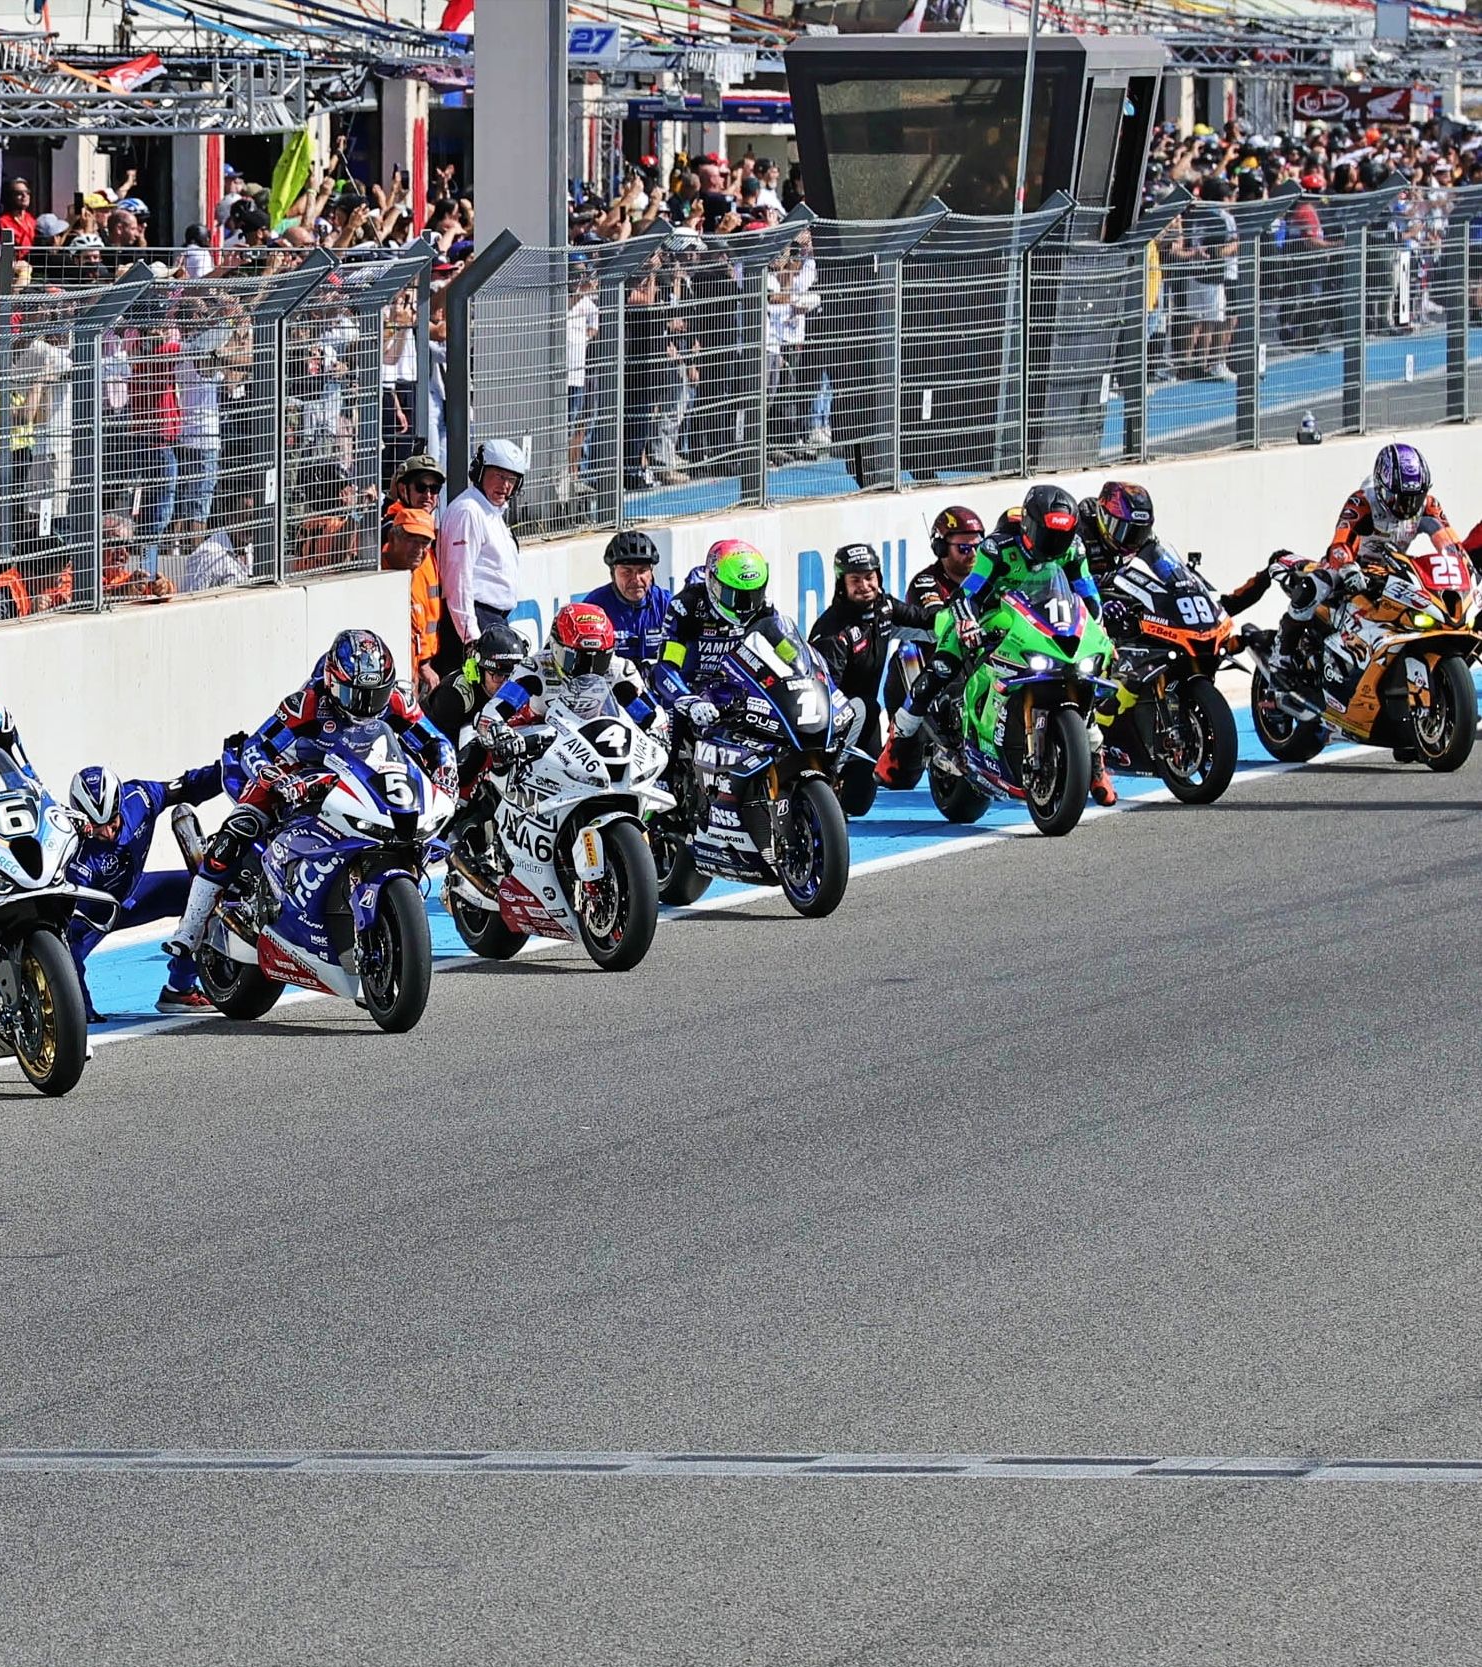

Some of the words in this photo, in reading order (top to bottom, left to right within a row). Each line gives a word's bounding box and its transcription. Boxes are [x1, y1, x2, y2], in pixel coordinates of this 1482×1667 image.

[568, 28, 616, 54] 27
[1429, 556, 1463, 585] 25
[1143, 614, 1169, 626] YAMAHA
[1176, 595, 1215, 625] 99
[1156, 627, 1178, 640] Beta
[797, 691, 822, 725] 1
[745, 713, 779, 730] QUS
[596, 725, 627, 748] 4
[564, 738, 600, 773] AVA6
[385, 773, 414, 806] 5
[316, 820, 341, 840] MOTUL
